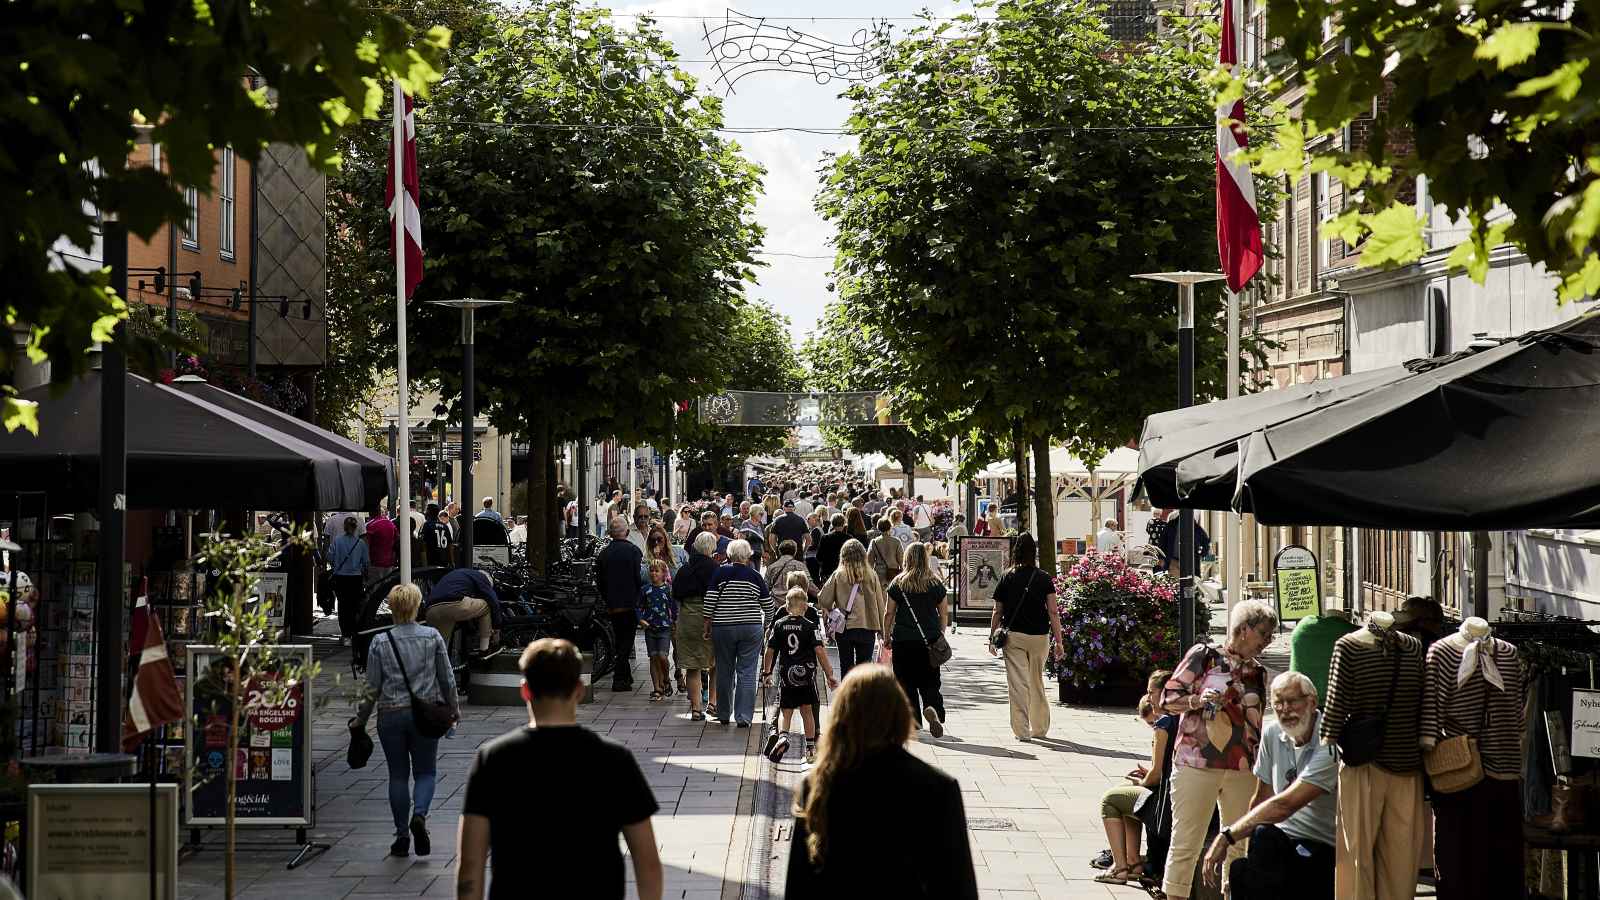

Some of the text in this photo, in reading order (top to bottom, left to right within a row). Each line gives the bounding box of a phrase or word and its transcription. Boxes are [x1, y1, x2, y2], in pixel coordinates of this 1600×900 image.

[434, 529, 448, 549] 16
[787, 633, 799, 655] 9
[248, 689, 297, 709] 20%
